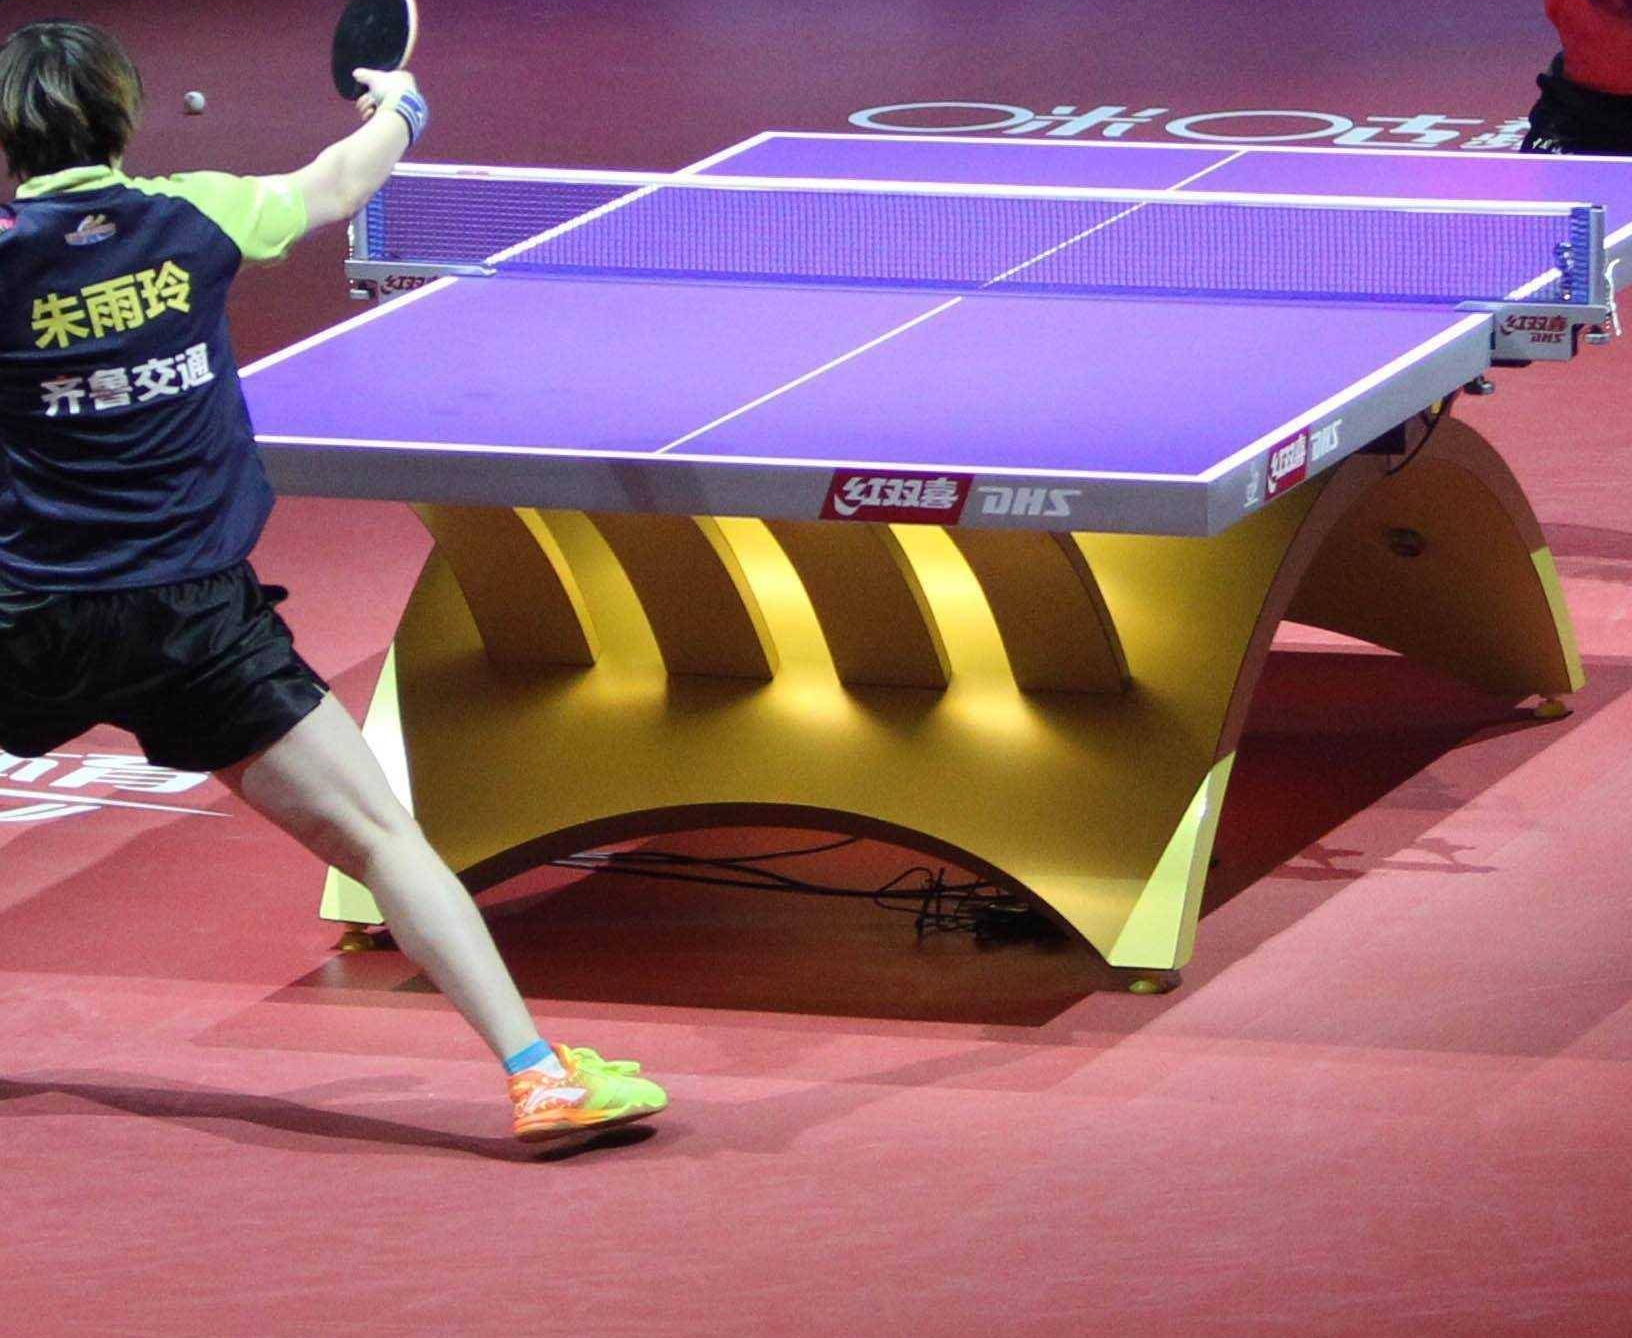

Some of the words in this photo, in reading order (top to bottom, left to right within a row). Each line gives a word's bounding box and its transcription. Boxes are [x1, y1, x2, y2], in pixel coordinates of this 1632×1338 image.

[30, 259, 192, 353] 朱雨玲
[39, 342, 214, 418] 齐鲁交通
[834, 475, 960, 517] 红双喜
[977, 485, 1082, 518] DHS
